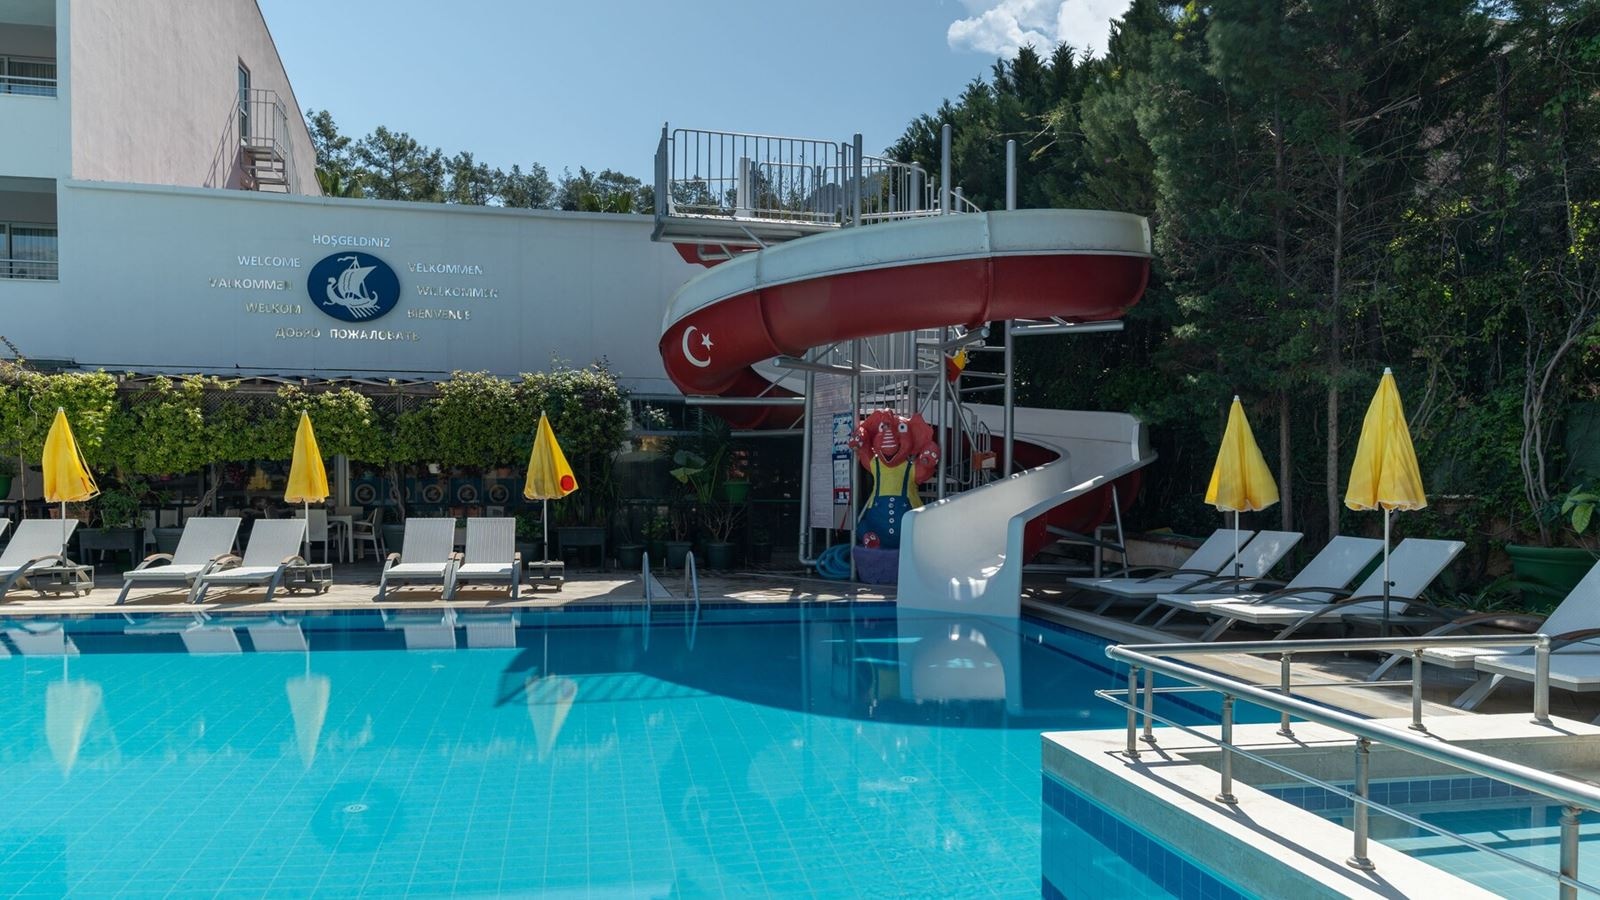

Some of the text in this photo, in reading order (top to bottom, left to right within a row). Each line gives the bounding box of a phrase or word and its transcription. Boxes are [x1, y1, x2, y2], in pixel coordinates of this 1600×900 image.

[237, 255, 301, 268] WELCOME
[407, 262, 484, 275] VELKOMMEN
[245, 303, 302, 314] WELKOM
[407, 308, 472, 320] BIENVENUE
[275, 327, 420, 341] ДОБРО ПОЖАЛОВАТЬ
